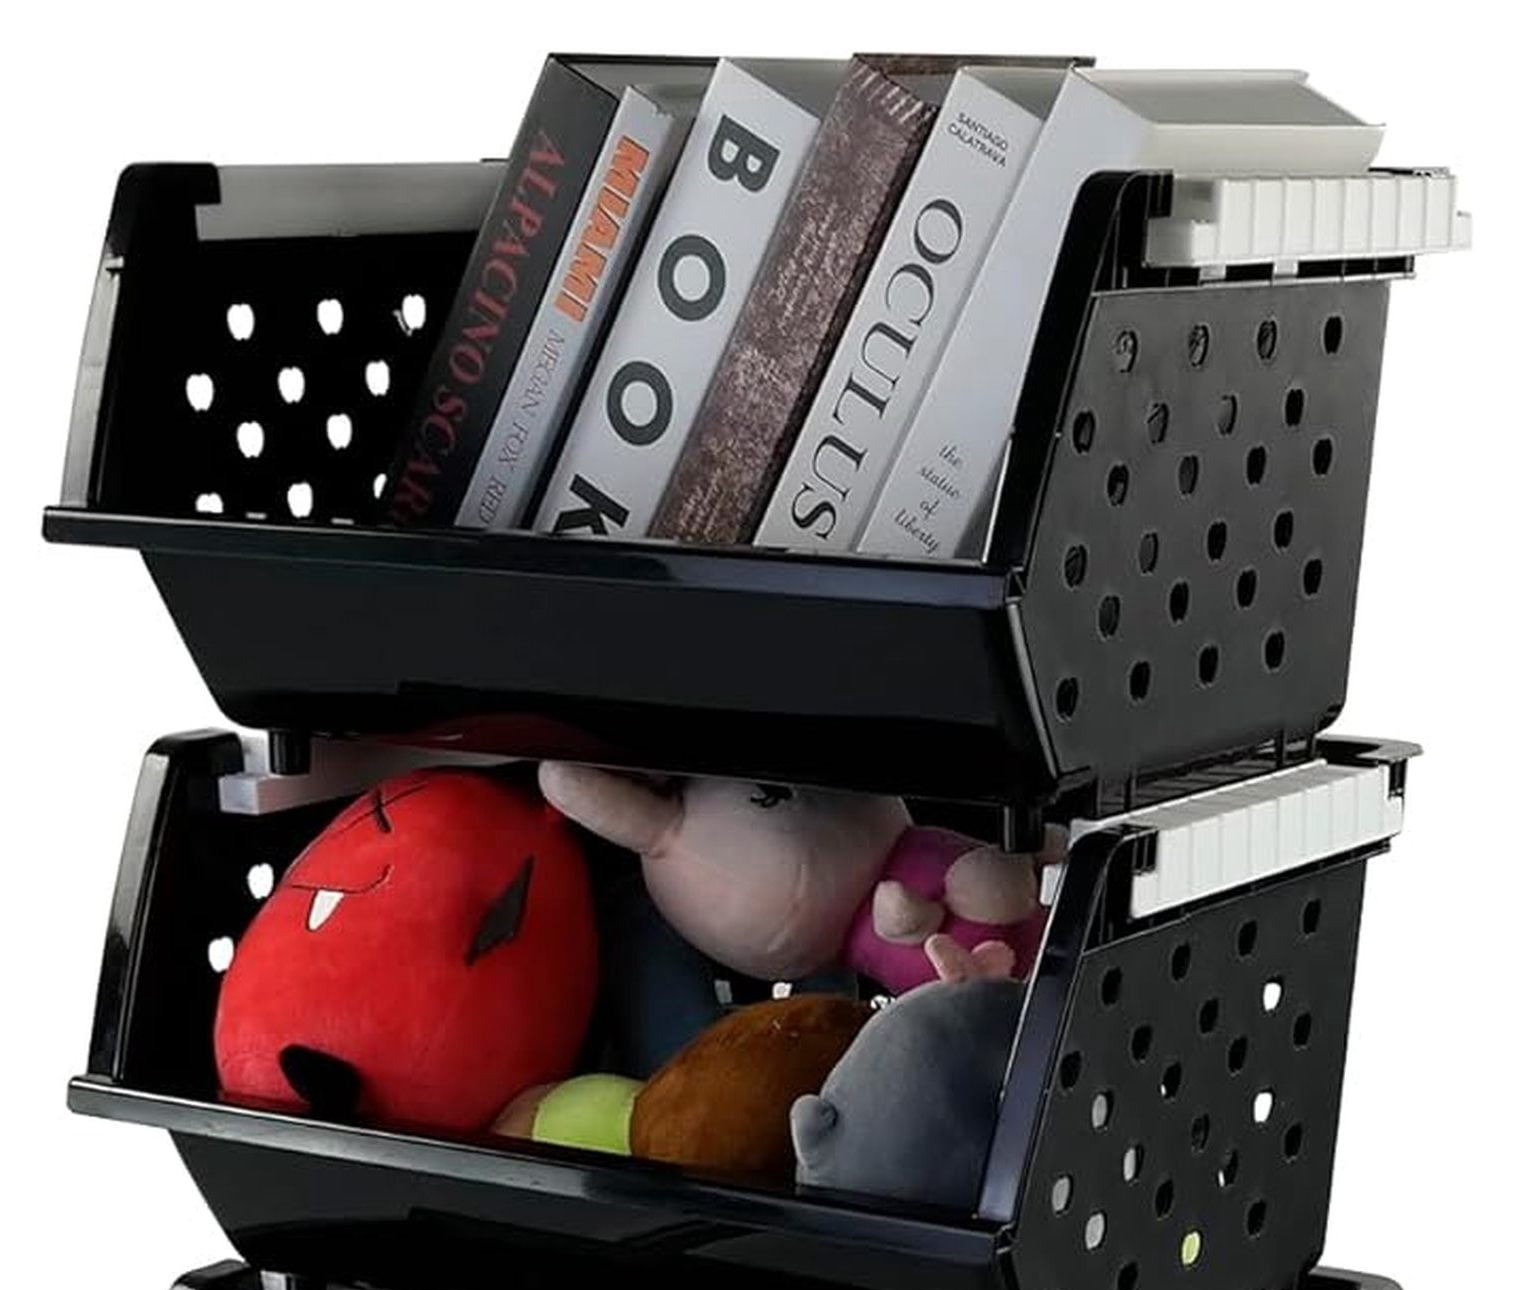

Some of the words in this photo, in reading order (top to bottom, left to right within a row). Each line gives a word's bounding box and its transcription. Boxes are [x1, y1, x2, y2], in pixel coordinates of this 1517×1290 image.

[553, 134, 651, 323] MIAMI
[790, 199, 963, 541] OCULUS
[499, 421, 529, 472] FOX
[939, 445, 961, 466] the
[920, 499, 940, 521] of
